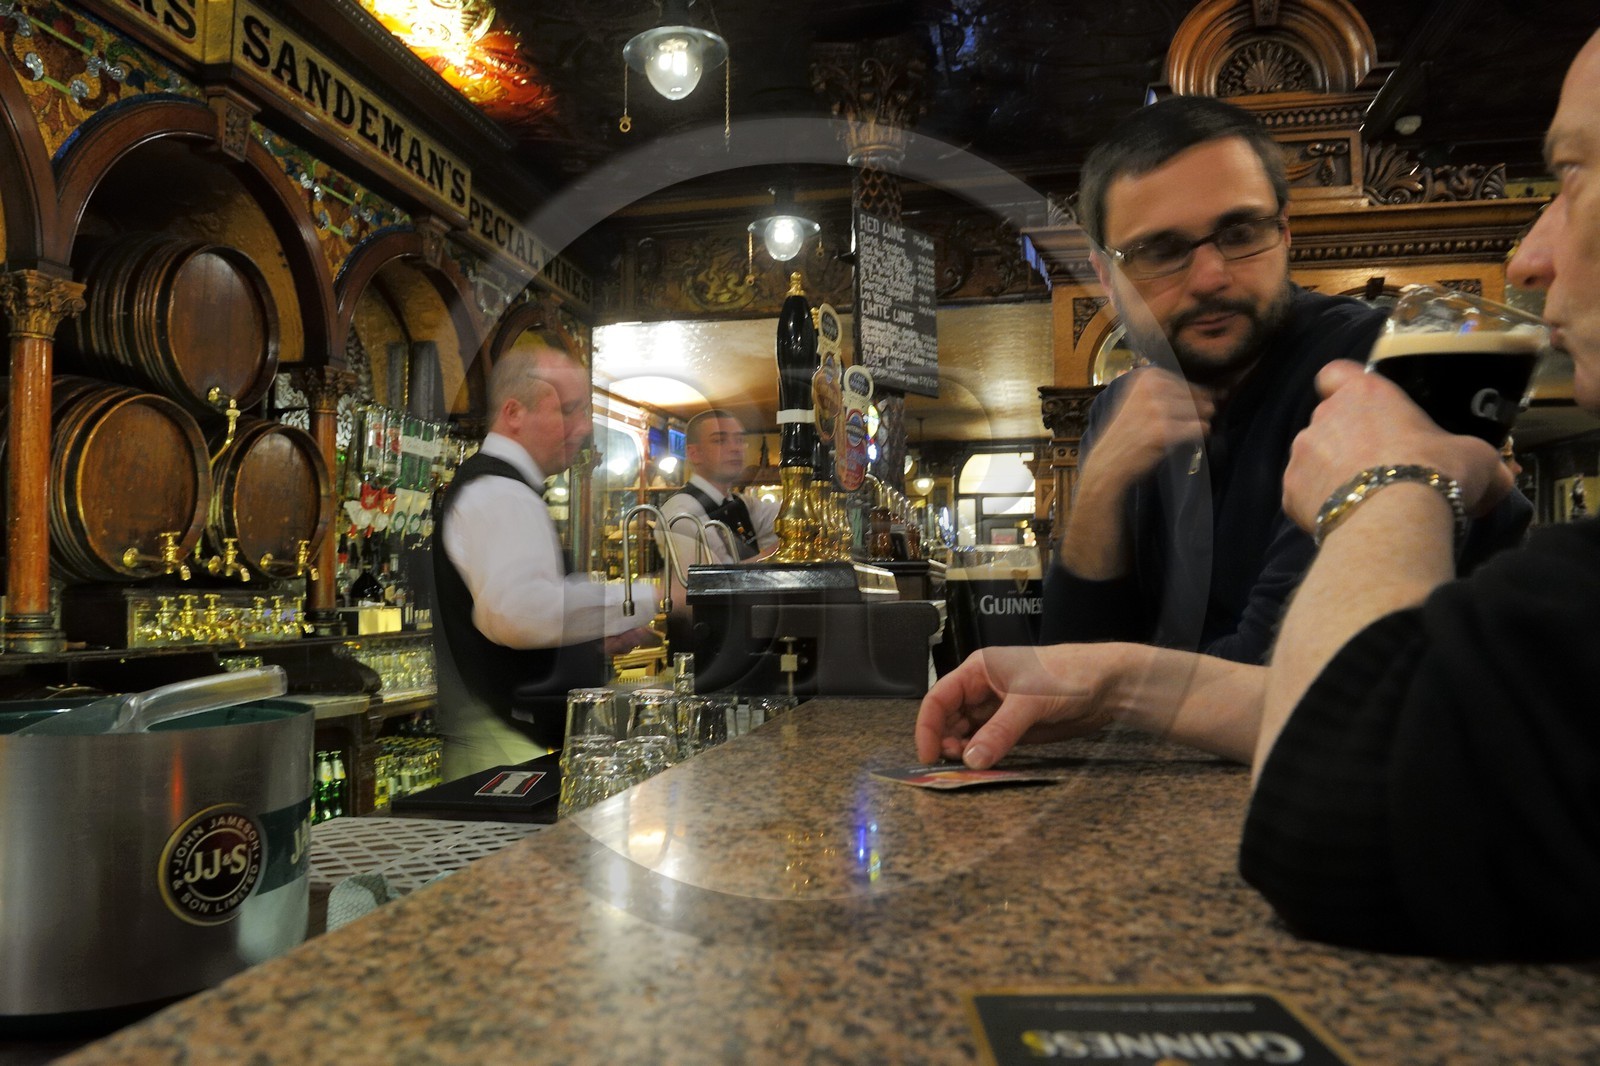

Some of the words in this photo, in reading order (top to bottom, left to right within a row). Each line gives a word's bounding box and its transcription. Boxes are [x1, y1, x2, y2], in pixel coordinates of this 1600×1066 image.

[242, 14, 466, 206] SANDEMAN'S
[469, 196, 539, 271] PECIAL
[543, 248, 592, 304] WINES
[860, 213, 880, 235] RED
[882, 222, 906, 244] WINE
[861, 299, 891, 320] WHITE
[893, 308, 914, 326] WINE
[173, 825, 205, 867] JOHN
[209, 815, 261, 852] JAMESON
[172, 879, 185, 890] &
[180, 891, 210, 913] SON
[215, 863, 259, 913] LIMITED
[1021, 1029, 1304, 1064] GUINNESS
